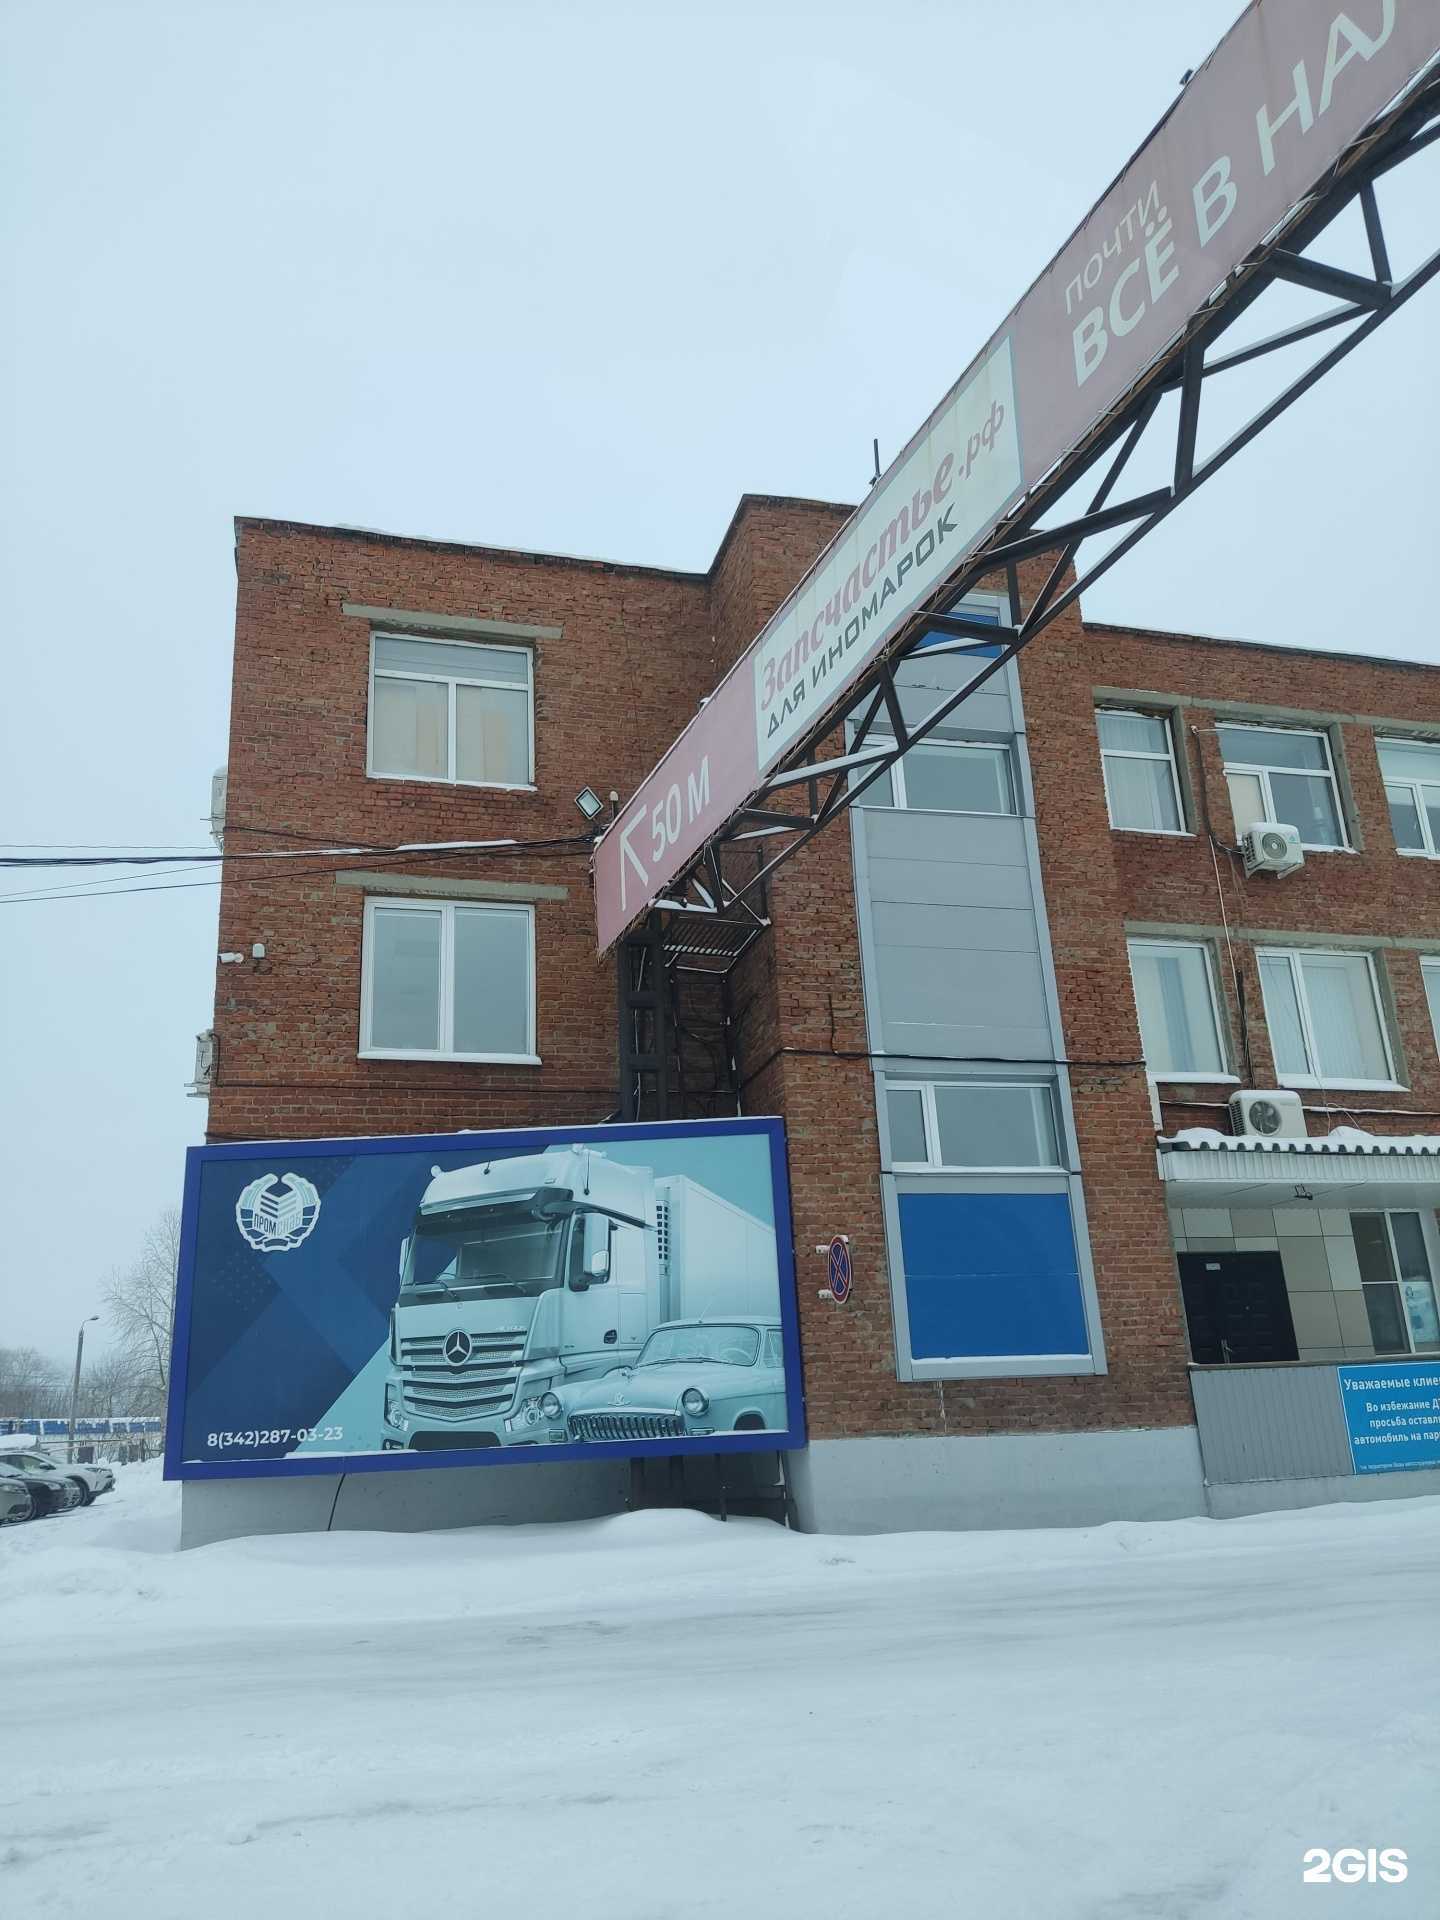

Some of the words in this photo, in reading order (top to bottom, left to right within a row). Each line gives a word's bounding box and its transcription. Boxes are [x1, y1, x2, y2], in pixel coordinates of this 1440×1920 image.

[1065, 180, 1160, 314] ПОЧТИ
[1072, 206, 1180, 388] ВСЁ
[1192, 155, 1238, 249] В
[767, 679, 806, 739] ДЛЯ
[812, 502, 960, 689] ИНОМАРОК
[652, 783, 682, 863] 50
[1344, 1378, 1411, 1390] Уважаемые
[1366, 1402, 1379, 1412] Во
[1380, 1400, 1431, 1411] избежание
[1370, 1416, 1407, 1429] просьба
[207, 1426, 344, 1449] 8(342)287-03-23
[1354, 1432, 1409, 1445] автомобиль
[1411, 1432, 1422, 1441] на
[1423, 1431, 1440, 1442] пар
